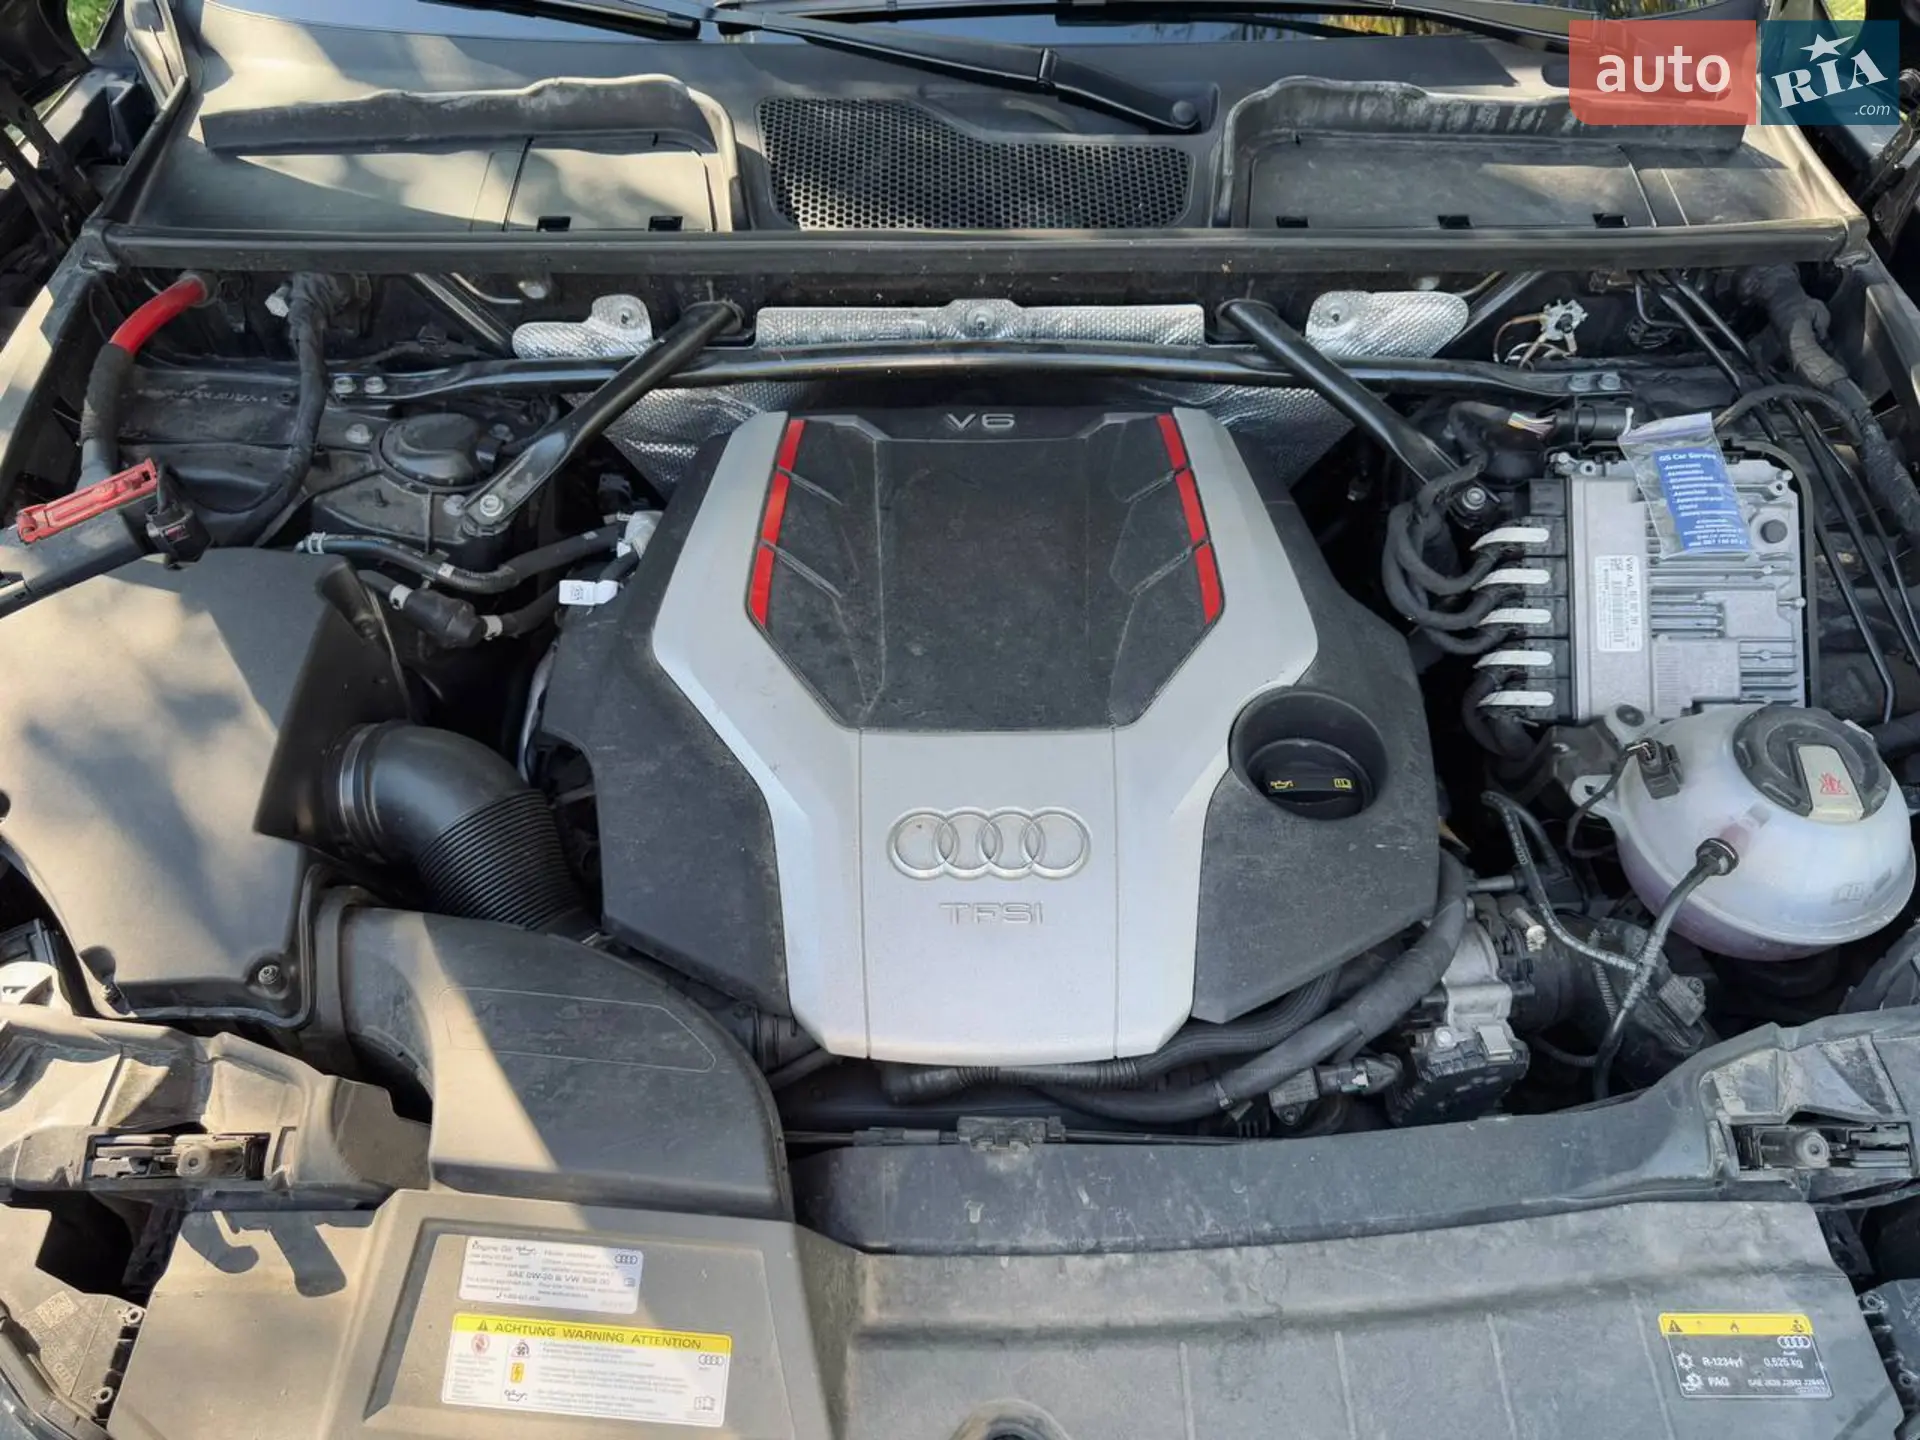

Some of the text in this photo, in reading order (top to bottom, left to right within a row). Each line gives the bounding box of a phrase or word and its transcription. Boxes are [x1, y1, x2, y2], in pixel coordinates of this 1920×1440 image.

[947, 413, 1015, 429] V6
[939, 902, 1043, 924] TFSI
[494, 1322, 702, 1349] ACHTUNG WARNING ATTENTION
